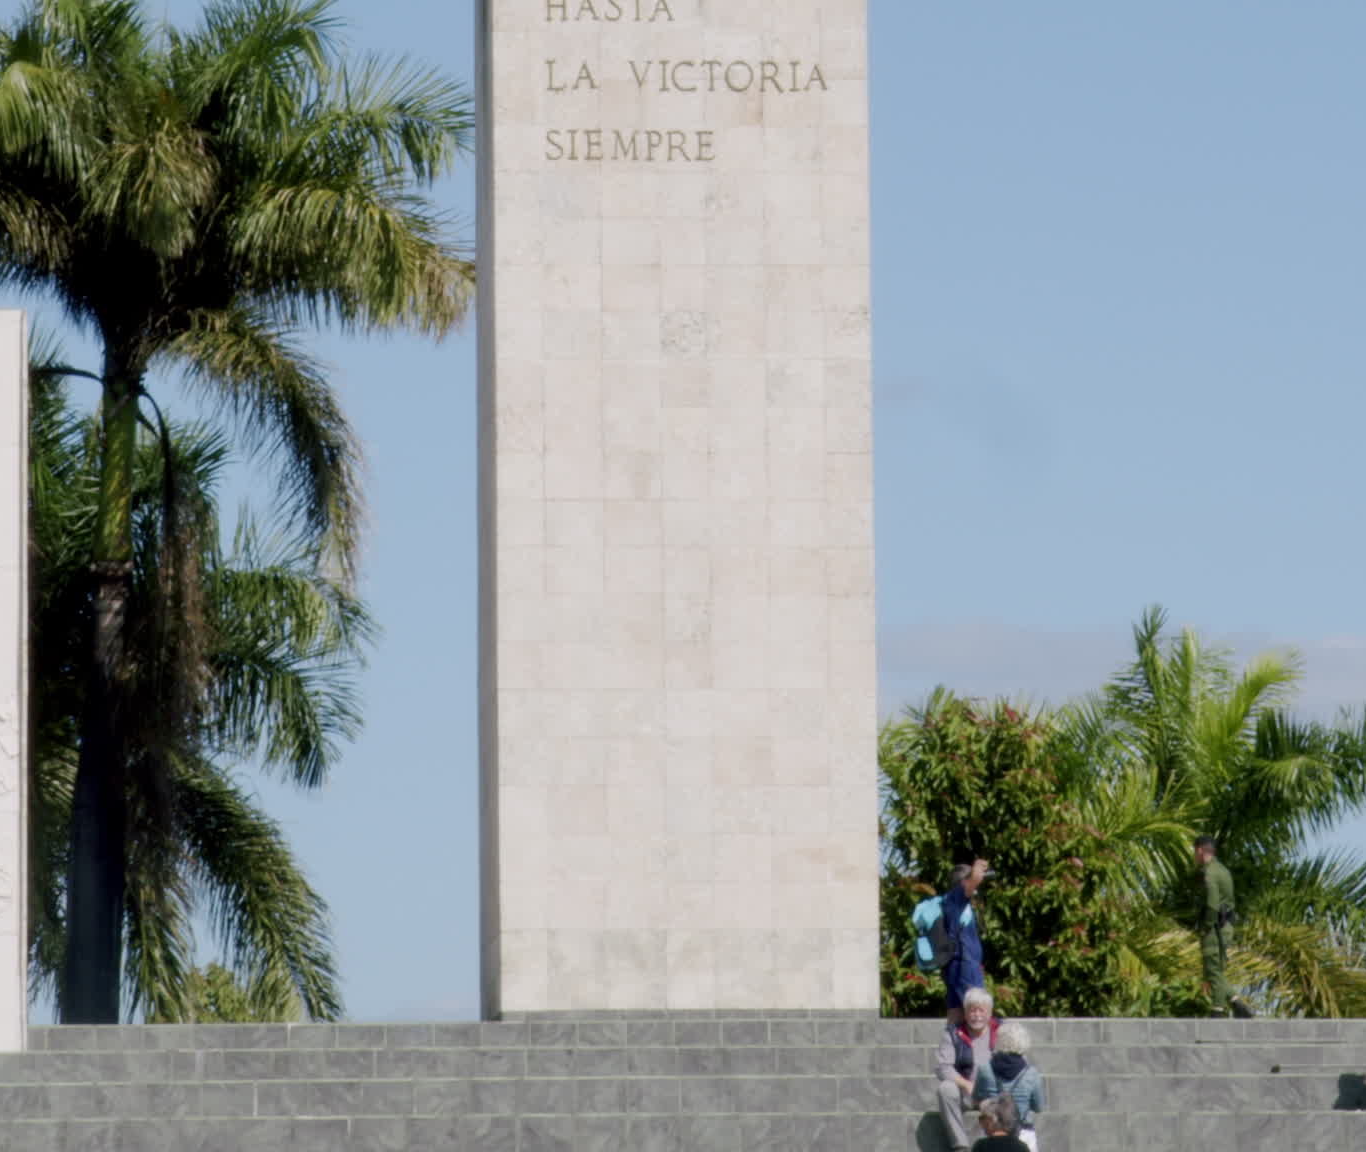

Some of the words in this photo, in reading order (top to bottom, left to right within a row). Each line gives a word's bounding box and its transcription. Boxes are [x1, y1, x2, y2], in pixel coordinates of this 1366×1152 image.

[545, 59, 601, 94] LA
[627, 59, 829, 94] VICTORIA
[545, 129, 716, 162] SIEMPRE
